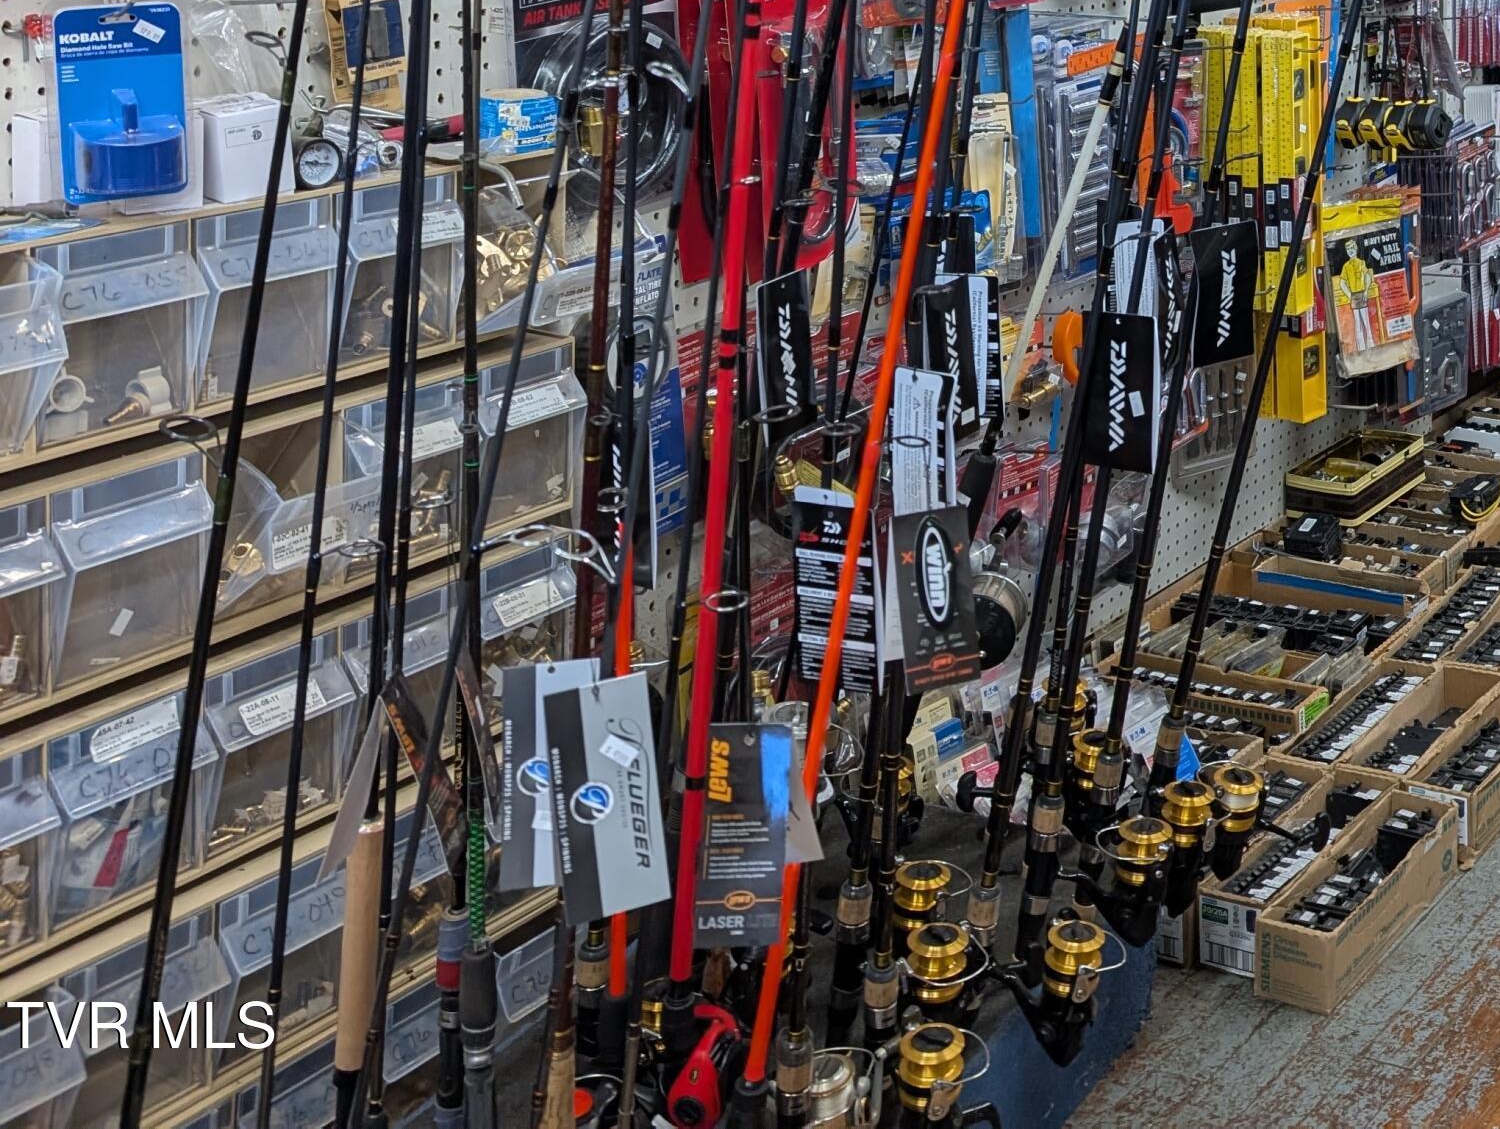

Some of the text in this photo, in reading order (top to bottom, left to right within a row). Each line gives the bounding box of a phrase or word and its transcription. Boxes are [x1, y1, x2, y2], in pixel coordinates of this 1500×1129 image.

[524, 9, 546, 26] AIR
[549, 1, 583, 20] TANK
[59, 31, 114, 45] KOBALT
[60, 46, 91, 54] Diamond
[1381, 233, 1397, 243] DUTY
[1383, 243, 1400, 254] NAIL
[1380, 253, 1402, 266] APRON
[1215, 247, 1236, 348] DAWA
[505, 719, 513, 755] MONARCH
[551, 747, 563, 785] MONARCH
[561, 837, 573, 875] SPINNING
[503, 805, 511, 841] SPINNING
[698, 915, 744, 930] LASER
[1261, 932, 1271, 992] SIEMENS
